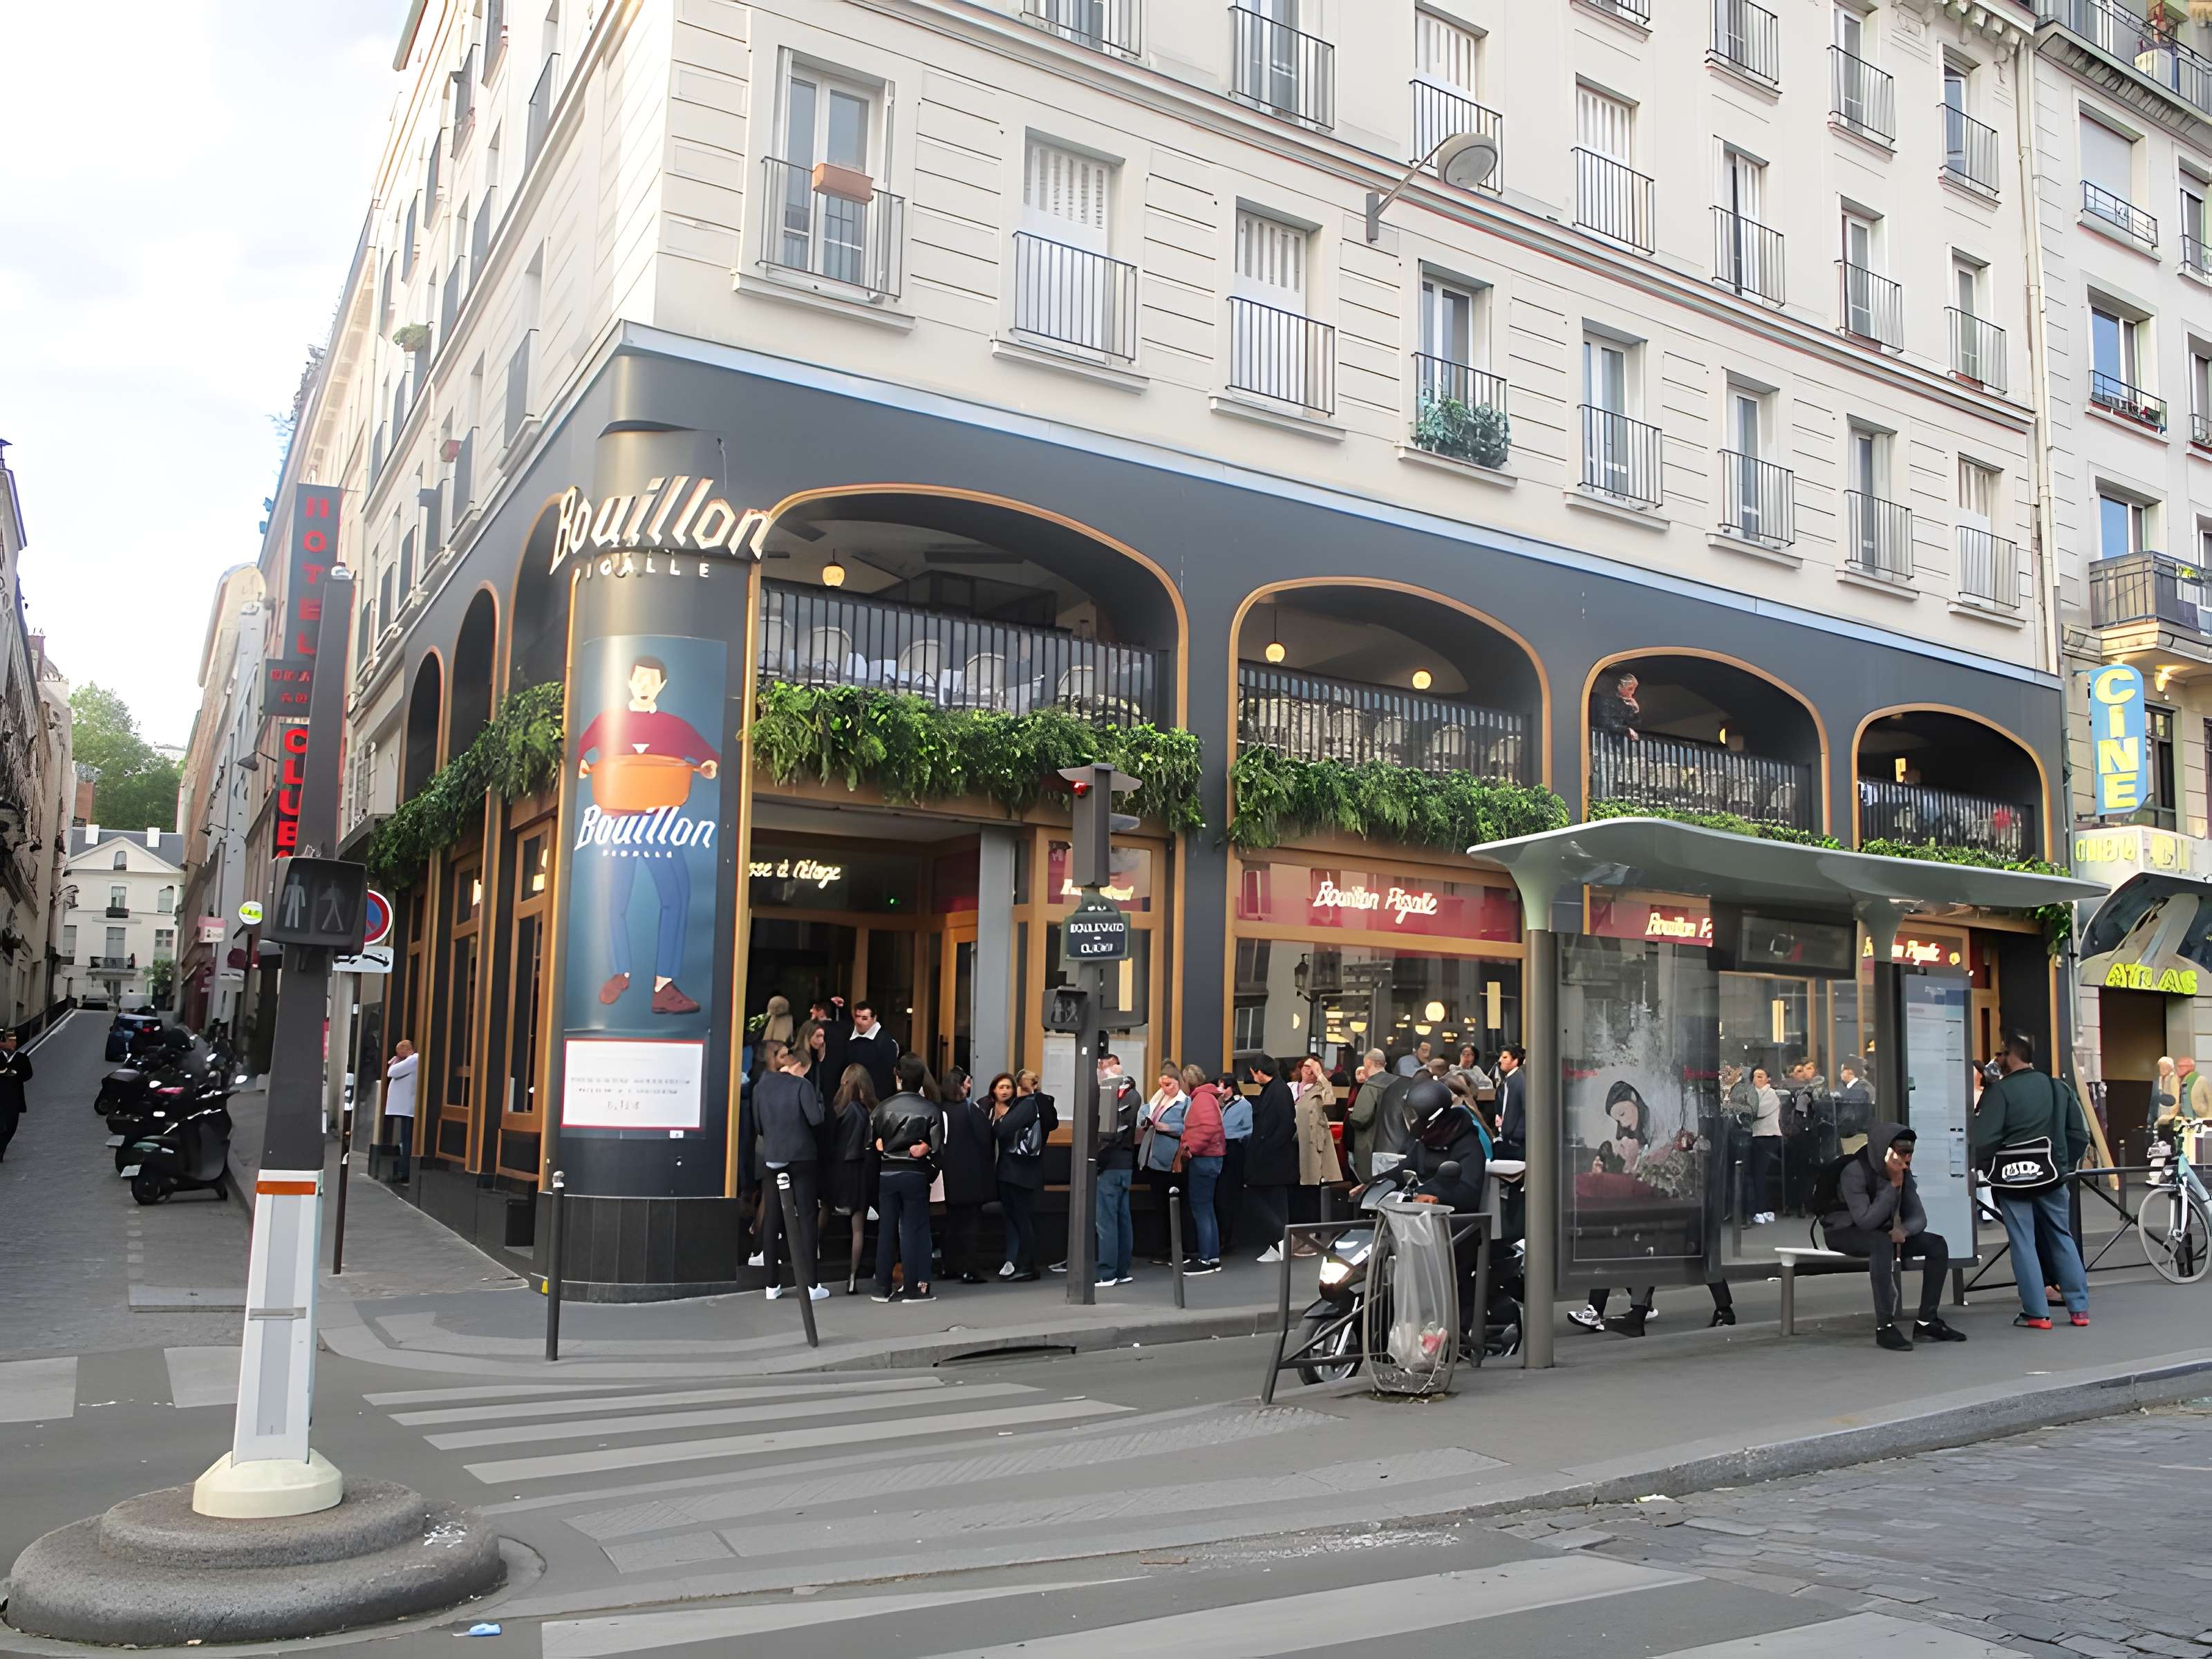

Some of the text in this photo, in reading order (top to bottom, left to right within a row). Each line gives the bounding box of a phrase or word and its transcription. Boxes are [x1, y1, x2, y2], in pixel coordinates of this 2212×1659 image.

[549, 475, 770, 575] Bouillon
[297, 497, 330, 657] HOTEL
[574, 804, 716, 850] Bouillon
